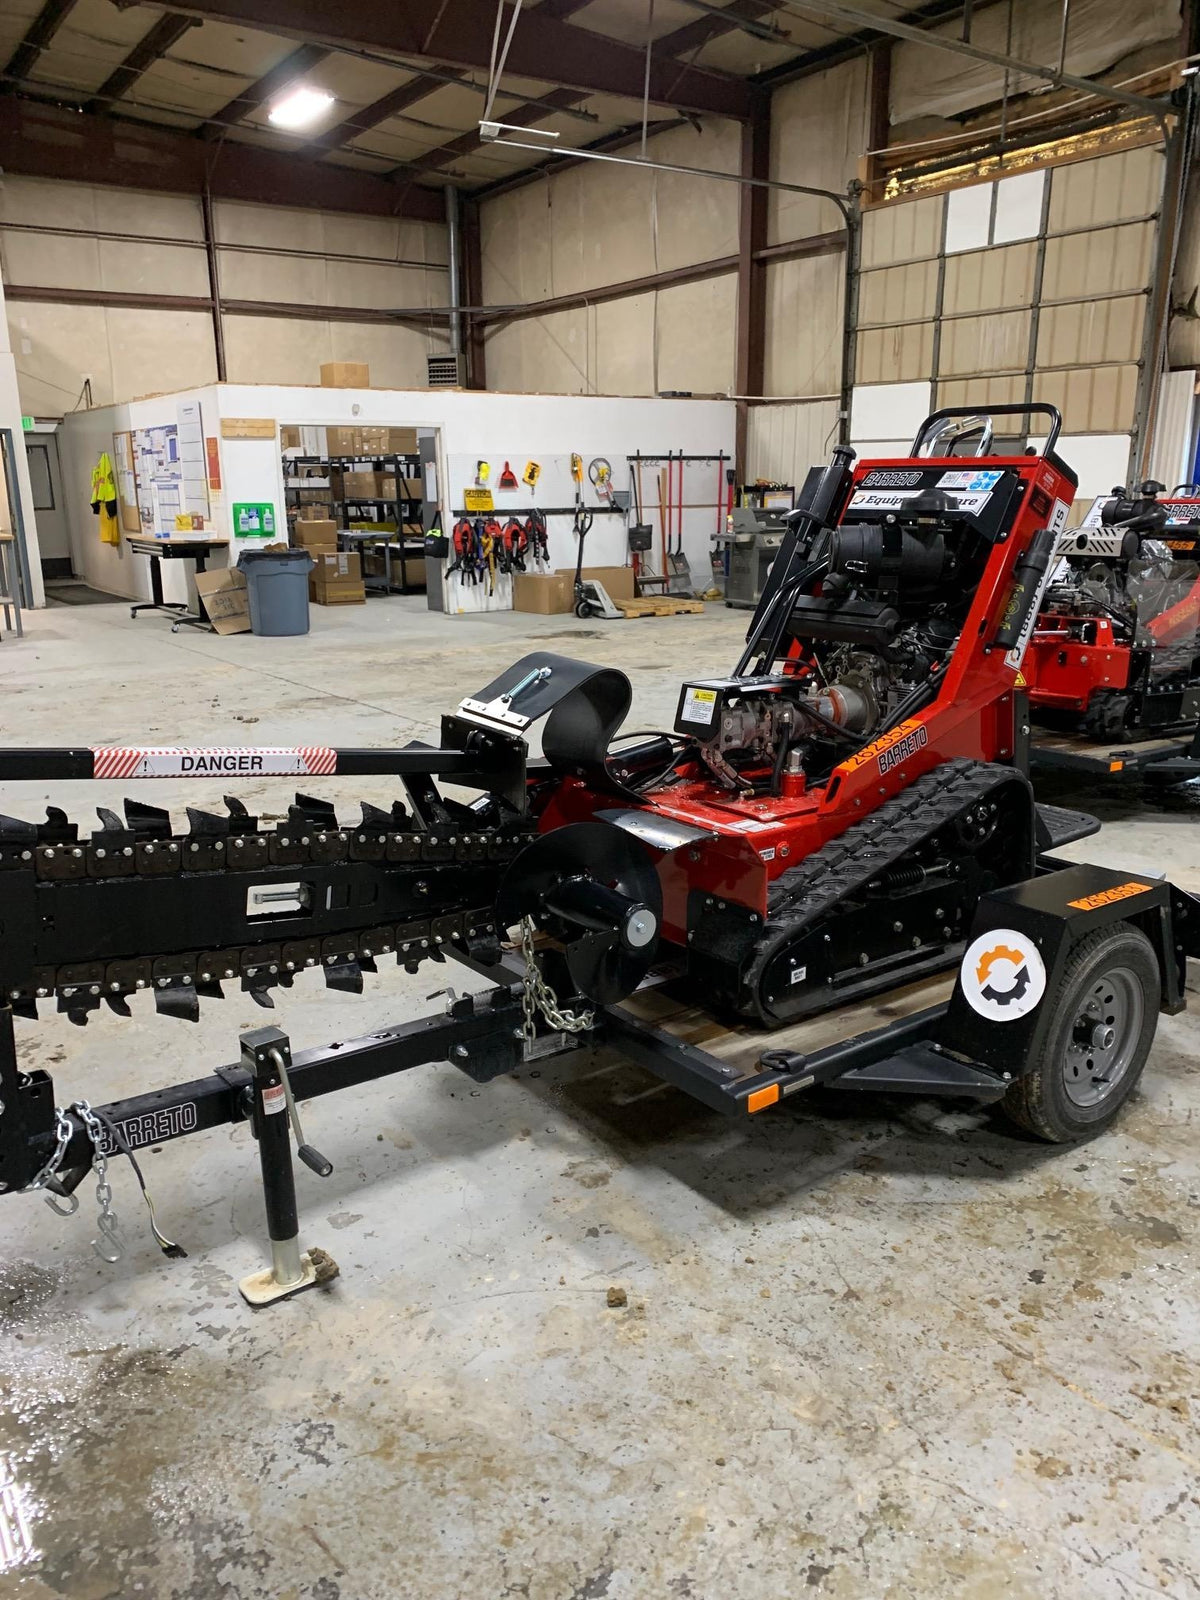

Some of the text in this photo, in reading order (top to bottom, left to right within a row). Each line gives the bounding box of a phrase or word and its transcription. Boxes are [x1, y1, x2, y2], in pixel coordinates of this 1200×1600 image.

[861, 471, 924, 487] BARRETO
[181, 755, 263, 771] DANGER
[877, 725, 928, 776] BARRETO
[92, 1101, 198, 1155] BARRETO
